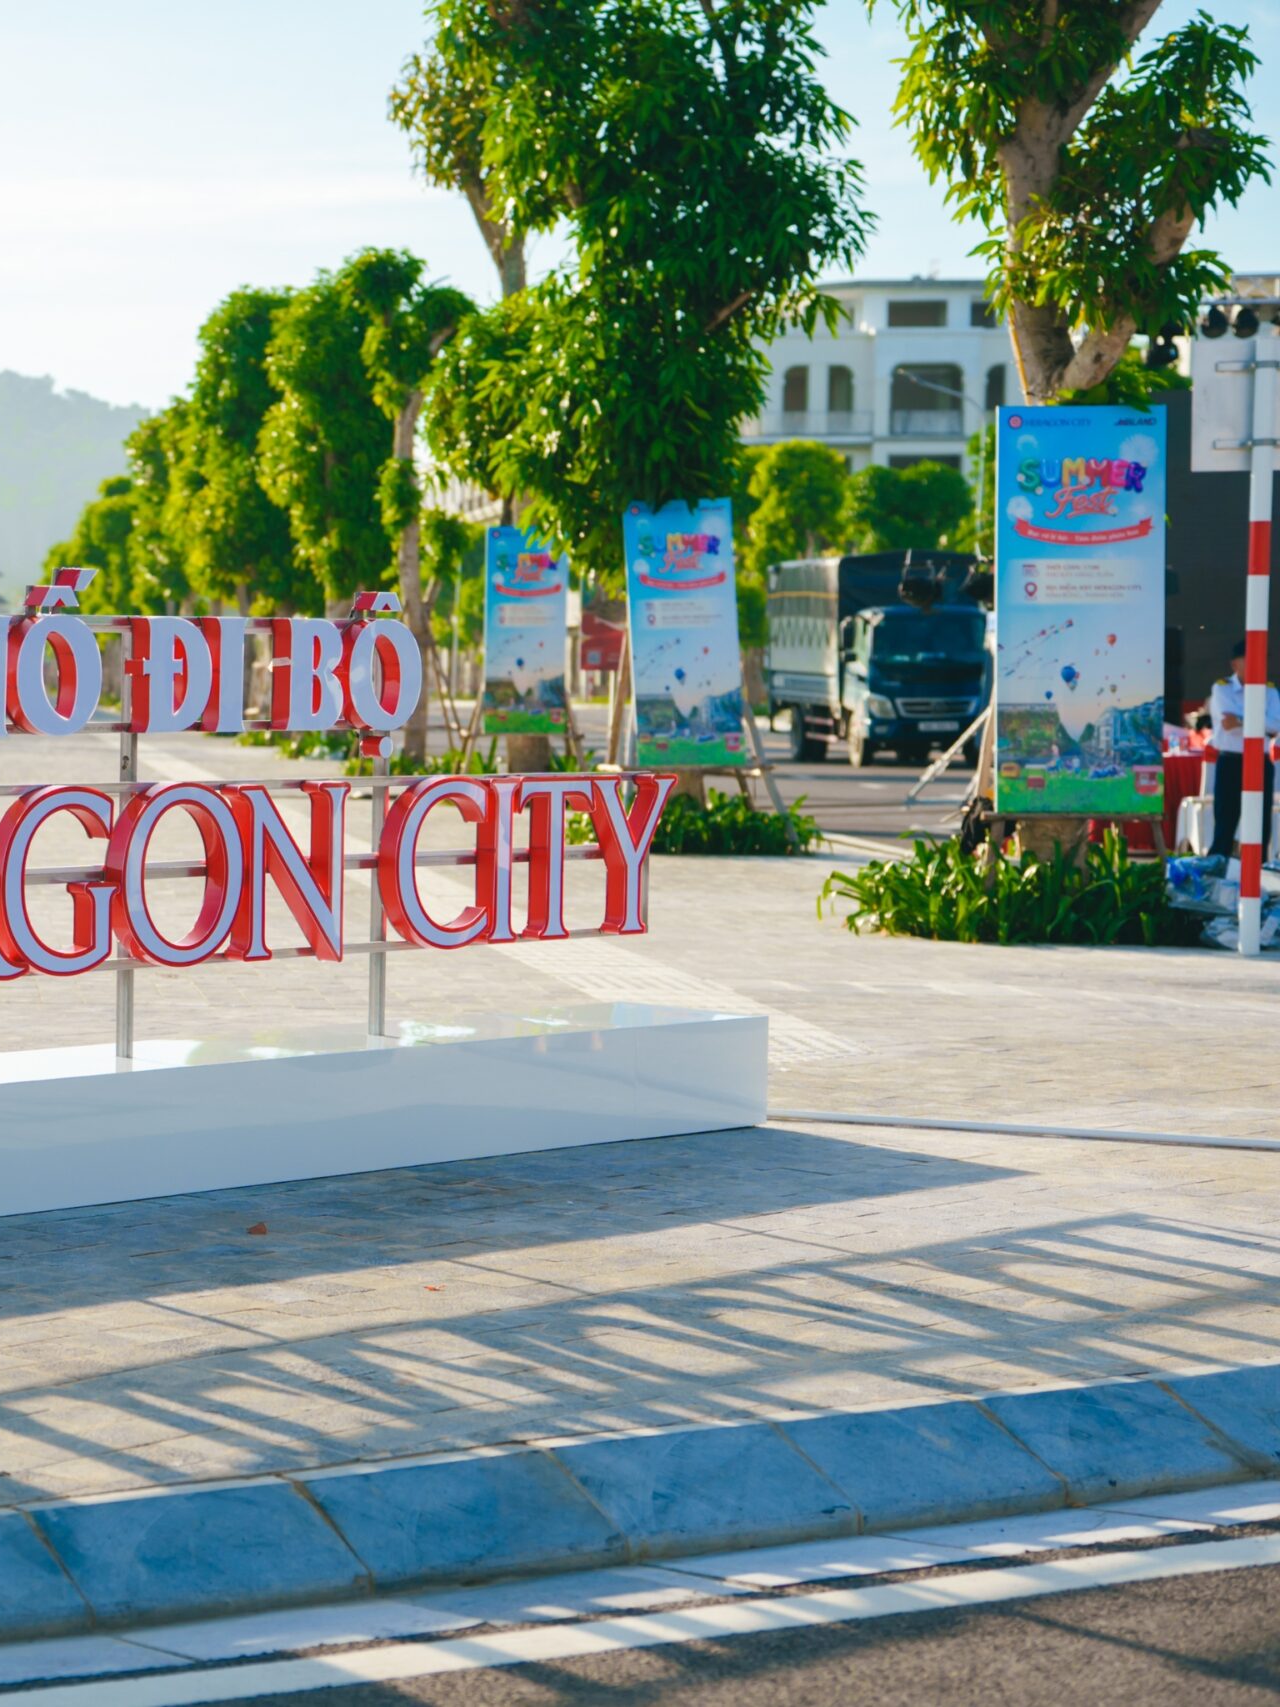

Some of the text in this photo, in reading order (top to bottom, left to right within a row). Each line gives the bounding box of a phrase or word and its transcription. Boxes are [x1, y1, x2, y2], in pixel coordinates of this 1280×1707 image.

[1018, 457, 1147, 494] SUMMER
[1045, 484, 1119, 519] Fest
[125, 615, 247, 733] ĐI
[272, 591, 422, 759] BỘ
[378, 774, 679, 951] CITY
